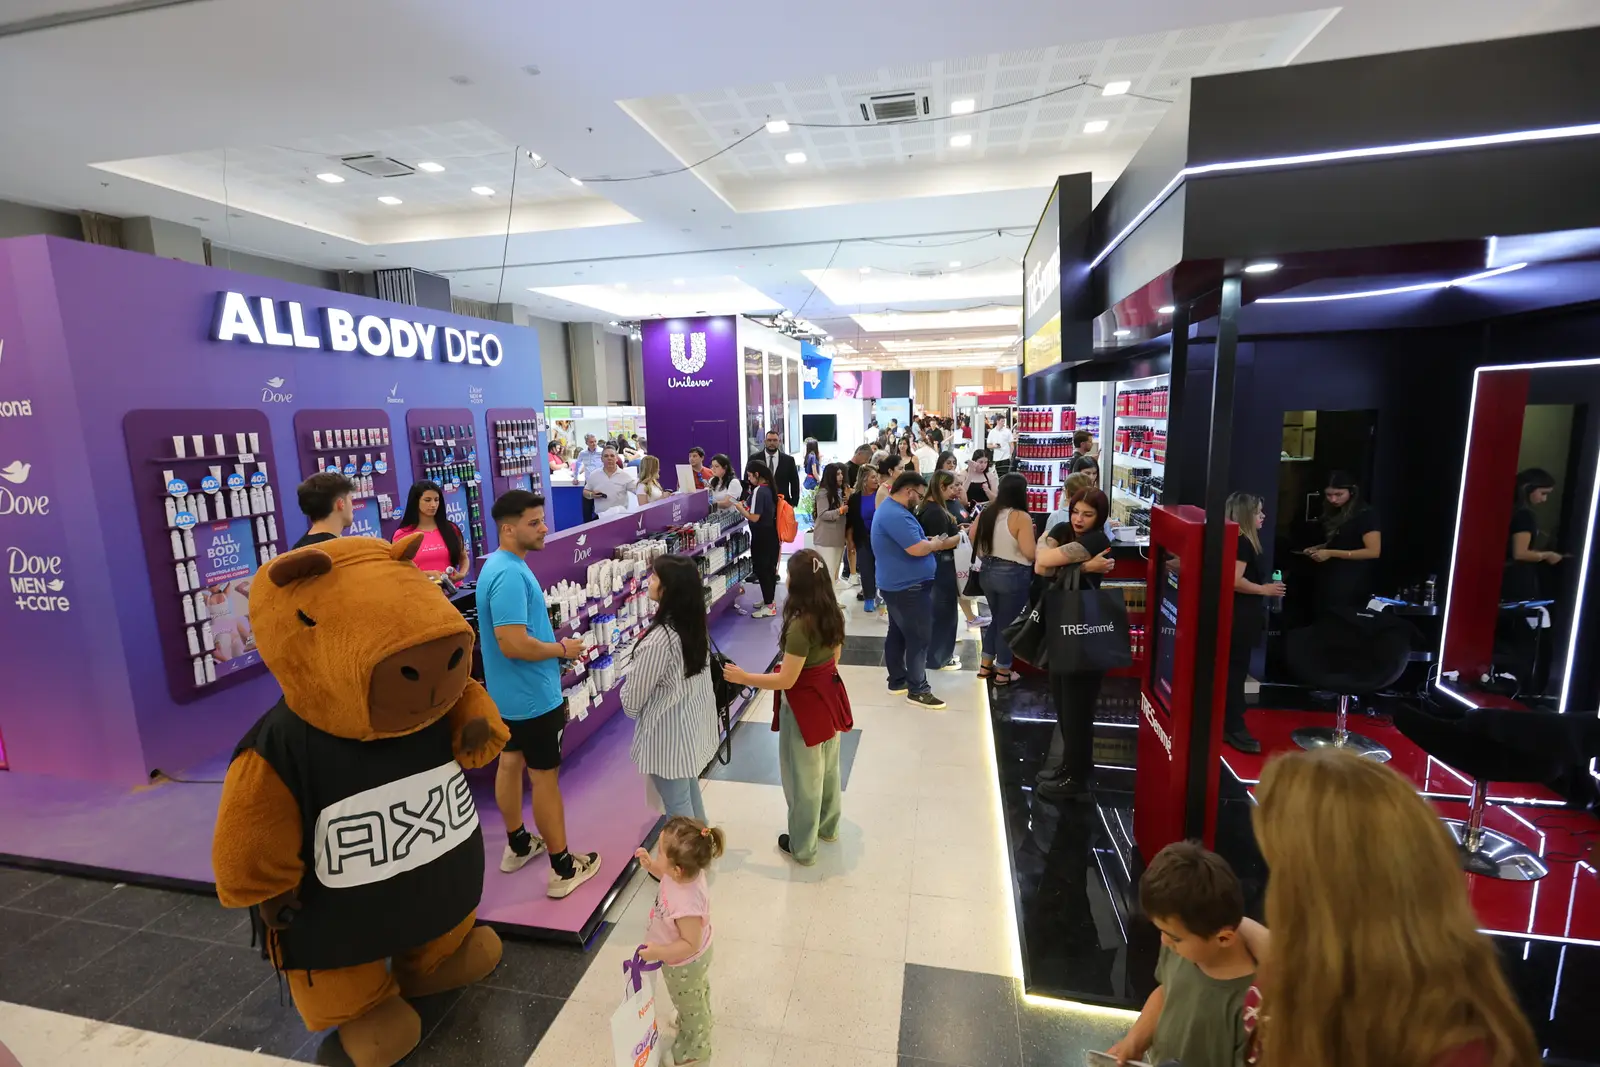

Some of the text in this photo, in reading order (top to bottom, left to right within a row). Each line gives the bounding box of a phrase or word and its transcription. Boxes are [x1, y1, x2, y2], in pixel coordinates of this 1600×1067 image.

[217, 291, 503, 367] ALL BODY DEO
[667, 376, 714, 389] Unilever
[261, 387, 293, 404] Dove
[0, 486, 50, 515] Dove
[446, 502, 462, 514] ALL
[448, 512, 467, 523] ODY
[349, 519, 372, 535] ALL
[212, 533, 234, 547] ALL
[207, 543, 240, 559] BODY
[574, 547, 592, 564] Dove
[6, 546, 61, 575] Dove
[213, 554, 239, 568] DEO
[10, 577, 47, 594] MEN
[15, 595, 70, 611] +care
[1060, 621, 1115, 636] TRESemmé
[325, 771, 476, 875] AXE
